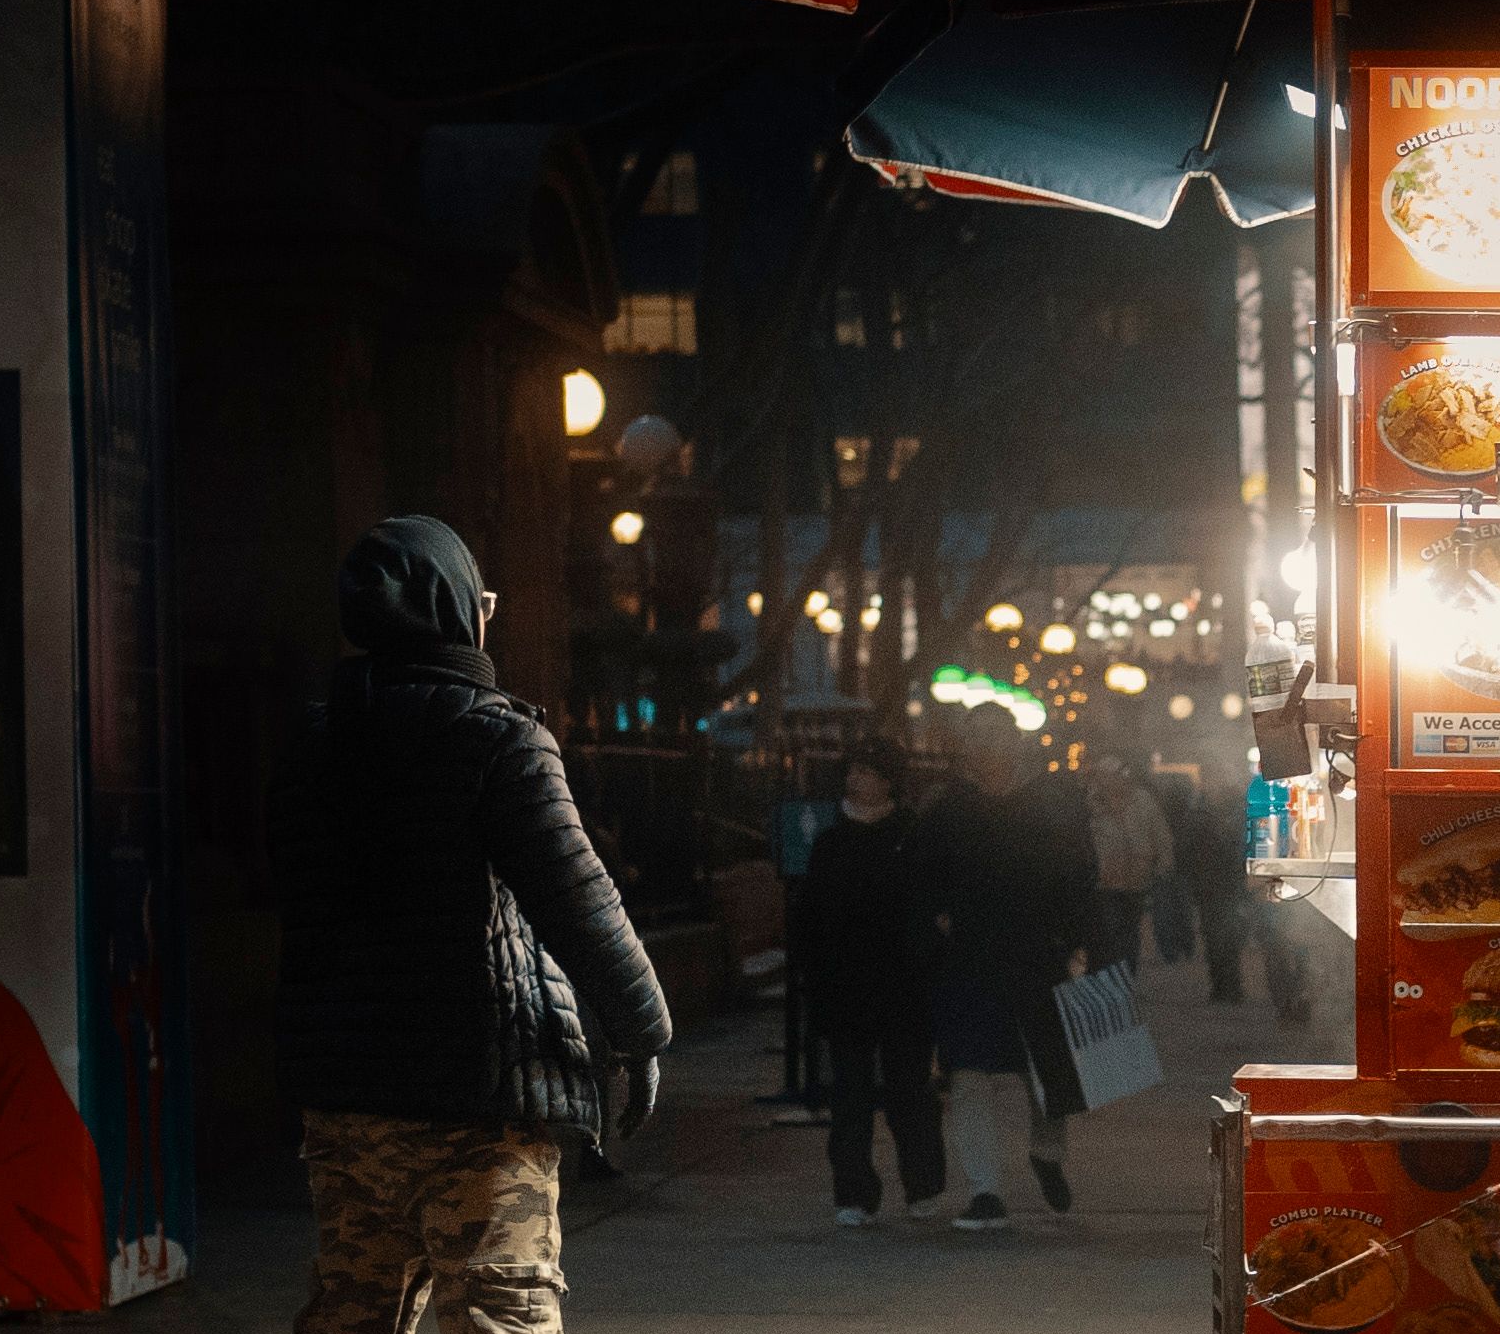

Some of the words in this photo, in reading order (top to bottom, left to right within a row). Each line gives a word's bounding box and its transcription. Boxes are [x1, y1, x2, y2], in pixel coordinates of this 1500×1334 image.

[1396, 122, 1476, 157] CHICKEN
[1400, 358, 1438, 380] LAMB
[1424, 716, 1453, 730] We
[1476, 740, 1497, 748] VISA
[1420, 820, 1455, 846] CHILI
[1270, 1207, 1319, 1228] COMBO
[1324, 1206, 1383, 1226] PLATTER
